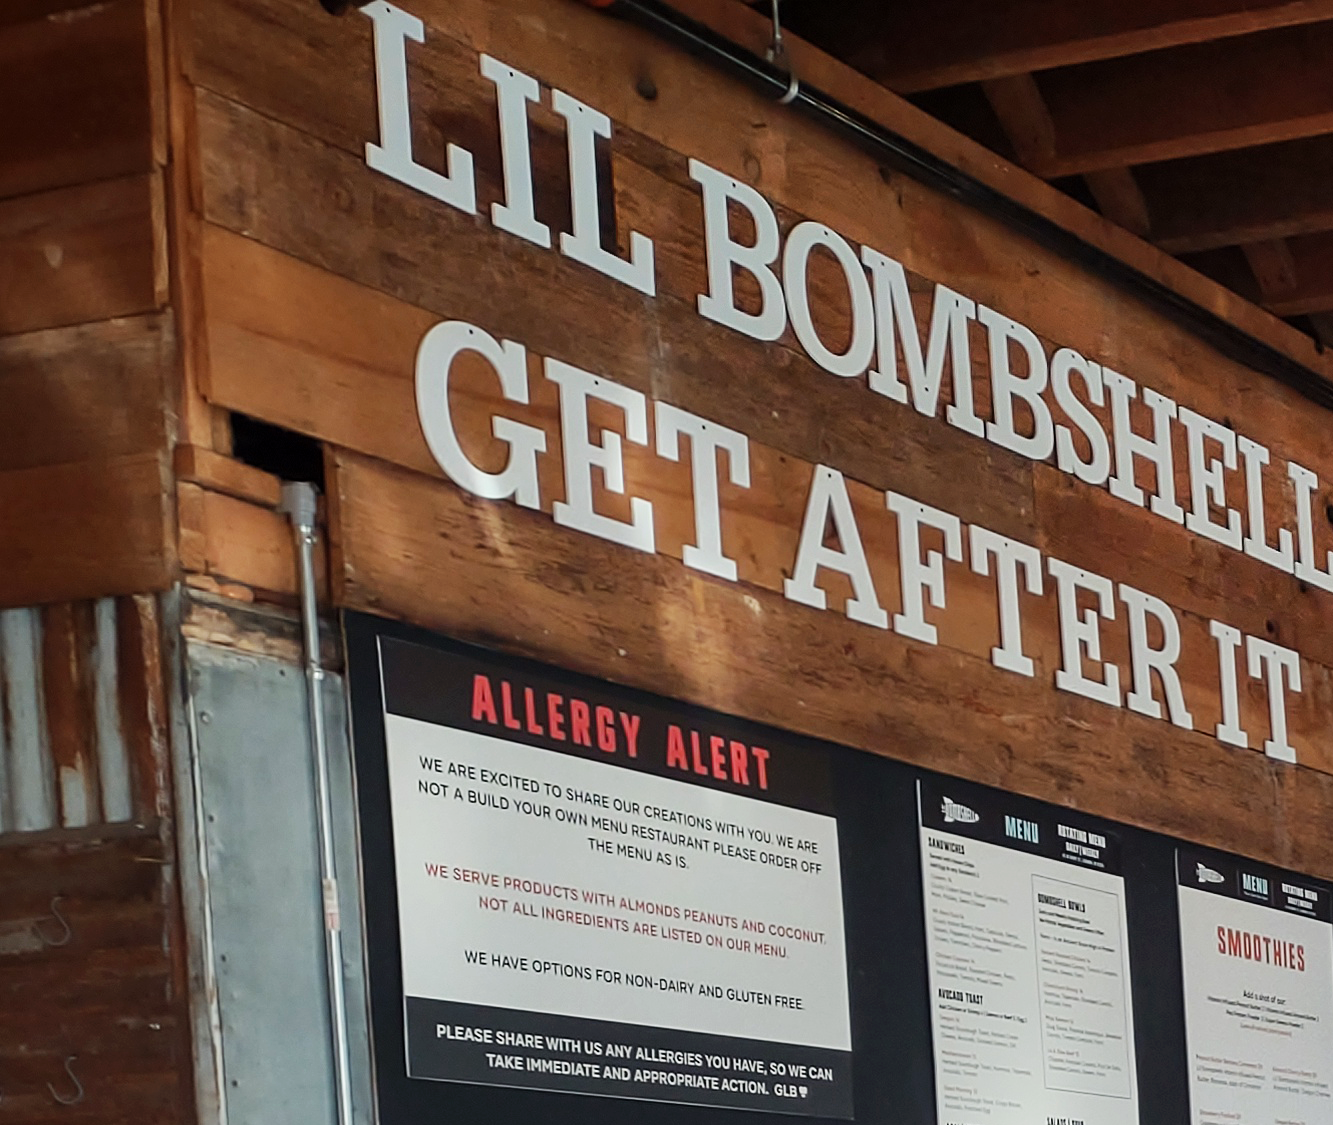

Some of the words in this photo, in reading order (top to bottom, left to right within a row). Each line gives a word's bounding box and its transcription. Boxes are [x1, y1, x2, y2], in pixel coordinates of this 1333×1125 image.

[365, 2, 655, 297] LIL
[414, 318, 751, 582] GET
[784, 466, 1194, 731] AFTER
[1208, 618, 1301, 765] IT
[471, 674, 640, 757] ALLERGY
[666, 725, 769, 789] ALERT
[418, 779, 448, 797] NOT
[453, 787, 463, 801] A
[467, 789, 509, 809] BUILD
[512, 798, 551, 819] YOUR
[554, 808, 587, 826] OWN
[591, 815, 627, 834] MENU
[631, 823, 709, 852] RESTAURANT
[713, 841, 756, 861] PLEASE
[759, 851, 797, 869] ORDER
[800, 860, 822, 874] OFF
[419, 755, 443, 773] WE
[447, 762, 476, 780] ARE
[480, 768, 539, 793] EXCITED
[542, 782, 561, 798] TO
[565, 787, 609, 808] SHARE
[612, 798, 639, 815] OUR
[643, 805, 712, 831] CREATIONS
[714, 820, 744, 838] WITH
[775, 833, 793, 849] WE
[796, 839, 818, 854] ARE
[1005, 815, 1039, 844] MENU
[587, 837, 613, 854] THE
[616, 843, 652, 861] MENU
[656, 851, 671, 865] AS
[424, 862, 448, 878] WE
[453, 867, 499, 887] SERVE
[503, 876, 578, 901] PRODUCTS
[581, 890, 615, 907] WITH
[619, 897, 680, 918] ALMONDS
[683, 908, 738, 929] PEANUTS
[741, 919, 765, 933] AND
[1243, 873, 1269, 895] MENU
[479, 896, 508, 911] NOT
[512, 901, 538, 917] ALL
[541, 905, 629, 932] INGREDIENTS
[632, 921, 657, 936] ARE
[661, 926, 702, 943] LISTED
[705, 934, 722, 947] ON
[726, 937, 750, 952] OUR
[1217, 926, 1304, 972] SMOOTHIES
[464, 949, 487, 965] WE
[491, 953, 528, 971] HAVE
[531, 959, 592, 980] OPTIONS
[595, 968, 621, 984] FOR
[625, 973, 694, 994] NON-DAIRY
[698, 984, 723, 998] AND
[726, 987, 771, 1005] GLUTEN
[436, 1024, 493, 1043] PLEASE
[495, 1030, 543, 1049] SHARE
[545, 1036, 581, 1053] WITH
[583, 1040, 602, 1055] US
[605, 1043, 632, 1058] ANY
[635, 1047, 702, 1066] ALLERGIES
[704, 1054, 730, 1069] YOU
[769, 1062, 786, 1075] SO
[787, 1064, 807, 1078] WE
[808, 1066, 832, 1081] CAN
[485, 1053, 523, 1070] TAKE
[526, 1057, 600, 1077] IMMEDIATE
[602, 1065, 631, 1080] AND
[633, 1069, 719, 1089] APPROPRIATE
[773, 1083, 797, 1097] GLB
